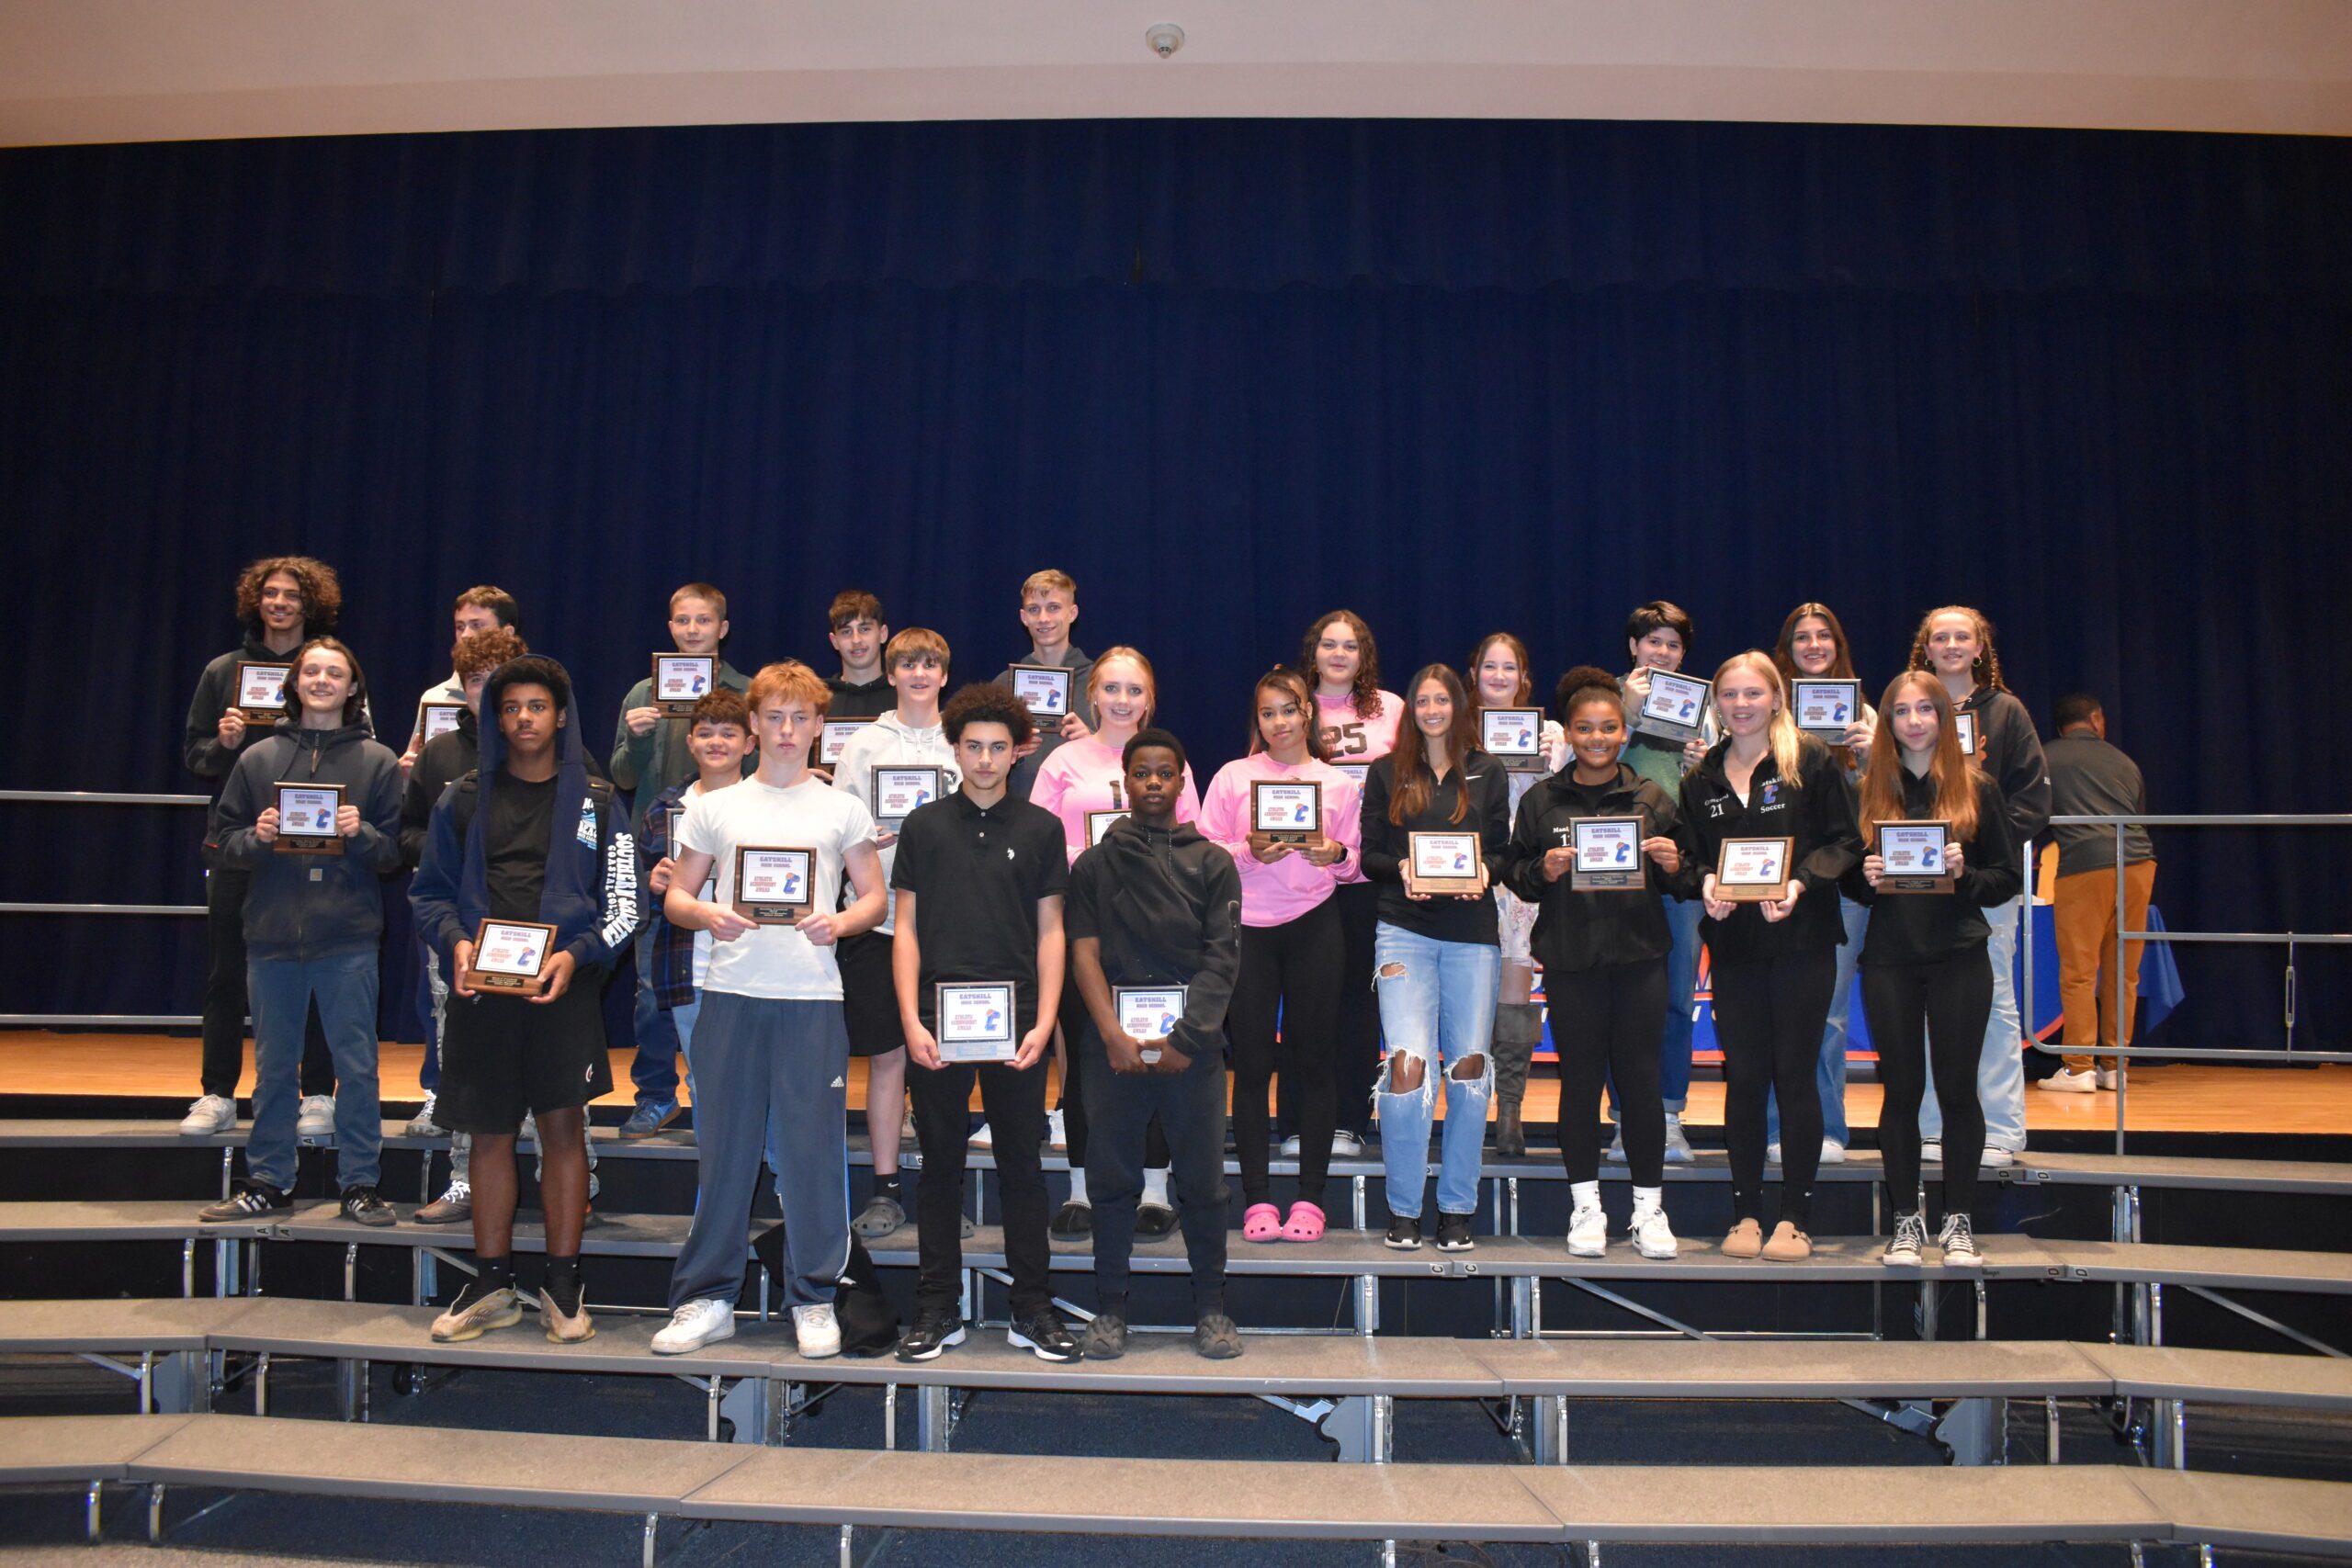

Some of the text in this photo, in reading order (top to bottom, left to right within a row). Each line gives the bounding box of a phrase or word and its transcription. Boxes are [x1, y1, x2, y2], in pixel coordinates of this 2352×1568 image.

[1321, 723, 1367, 758] 25
[1710, 803, 1724, 818] 21
[1760, 803, 1785, 814] Soccer
[1560, 833, 1570, 846] 1
[605, 845, 616, 890] COASTAL
[616, 832, 638, 899] SOUTHERN
